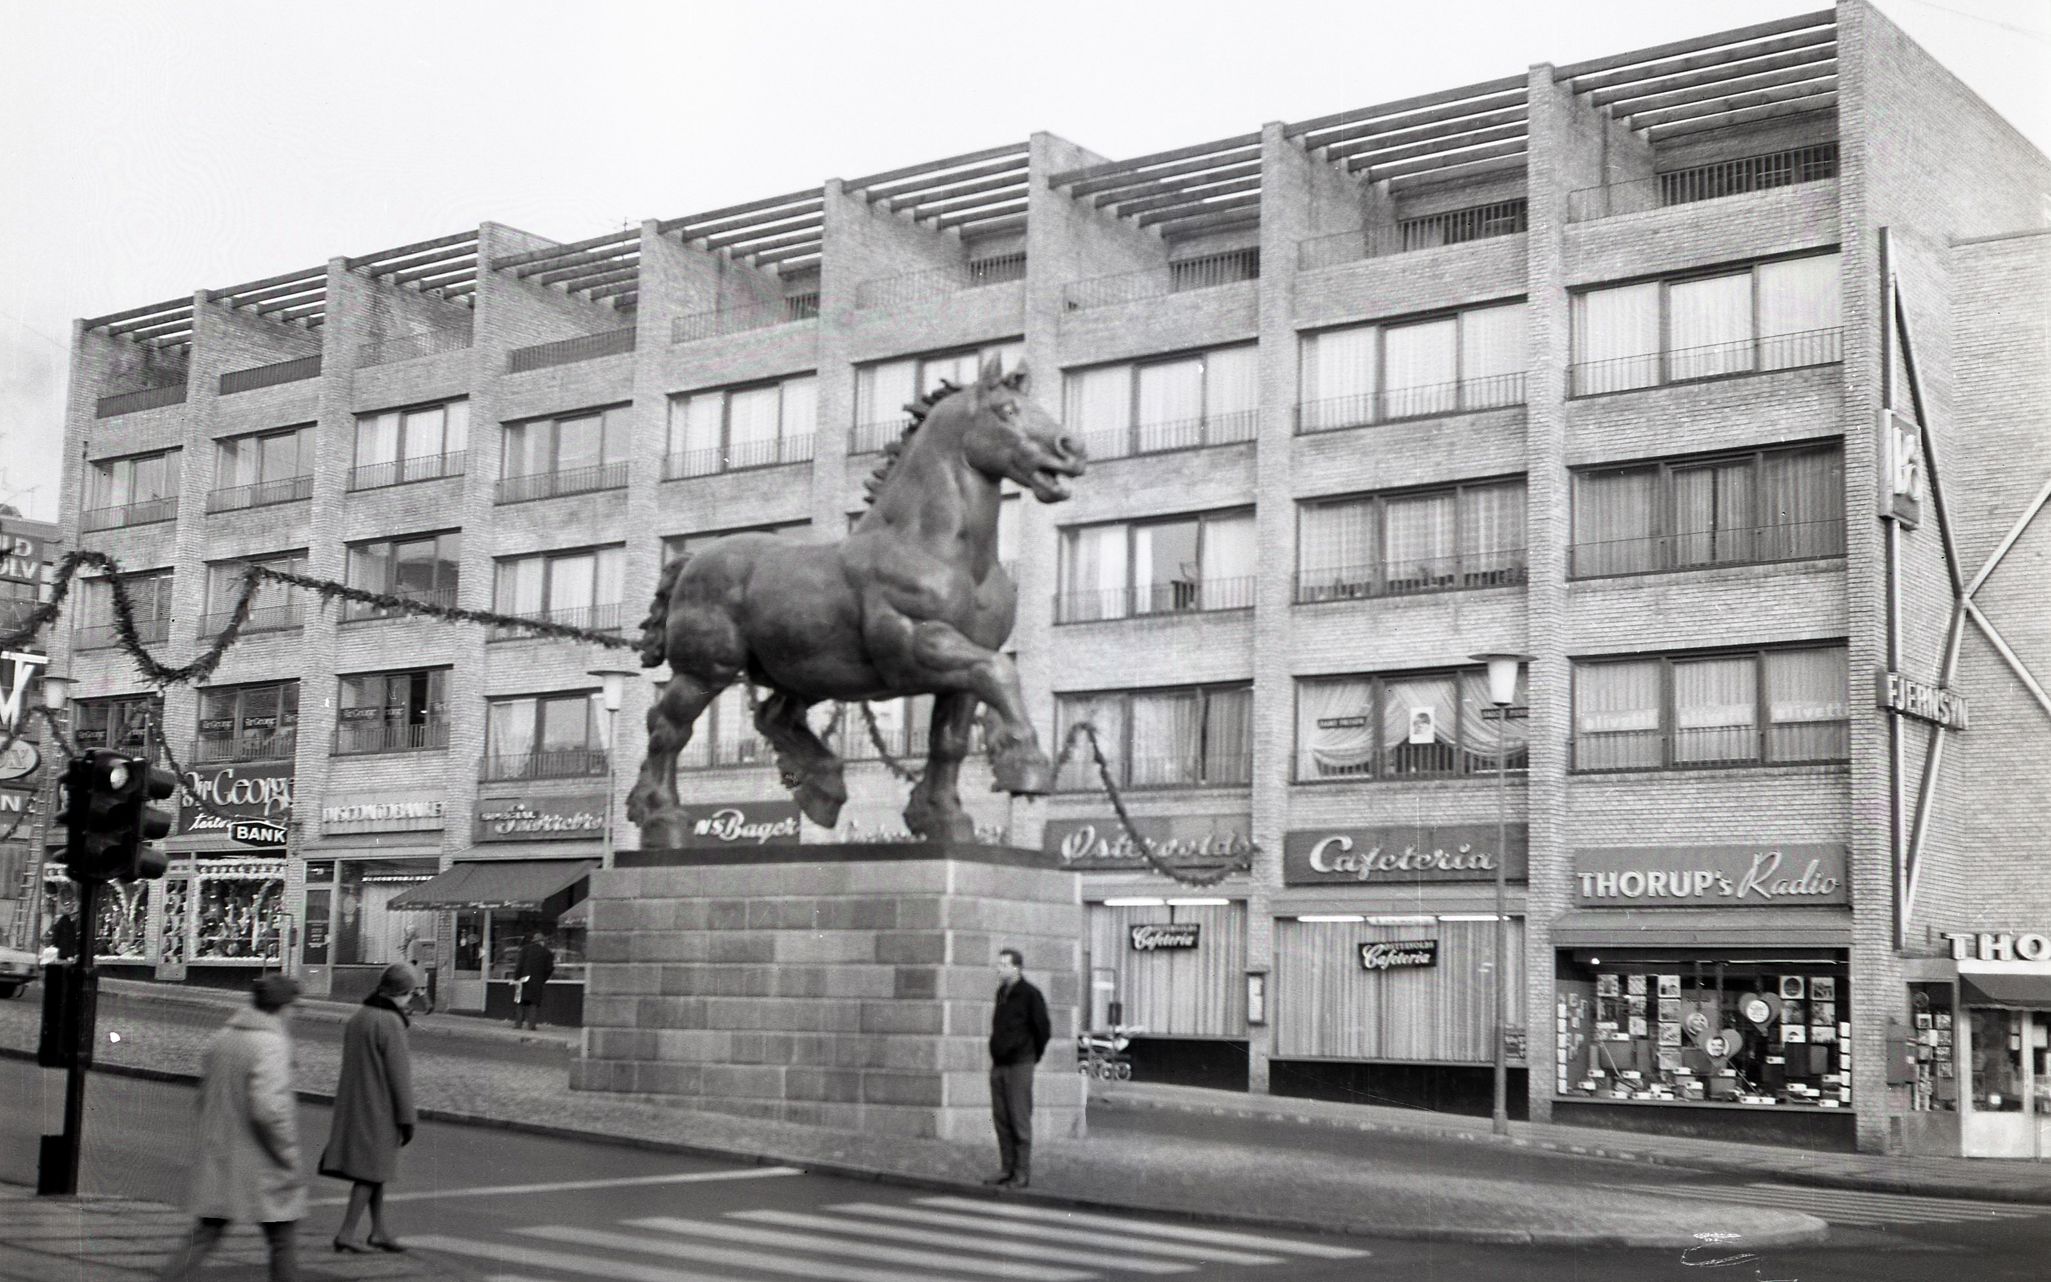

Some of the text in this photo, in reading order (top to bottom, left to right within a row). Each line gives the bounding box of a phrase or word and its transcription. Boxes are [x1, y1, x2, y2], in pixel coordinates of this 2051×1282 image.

[1887, 674, 1969, 730] FJERNSYN
[236, 826, 286, 842] BANK
[1309, 835, 1498, 880] Cafeteria
[1578, 850, 1840, 899] THORUP's Radio
[1943, 932, 2051, 961] THO
